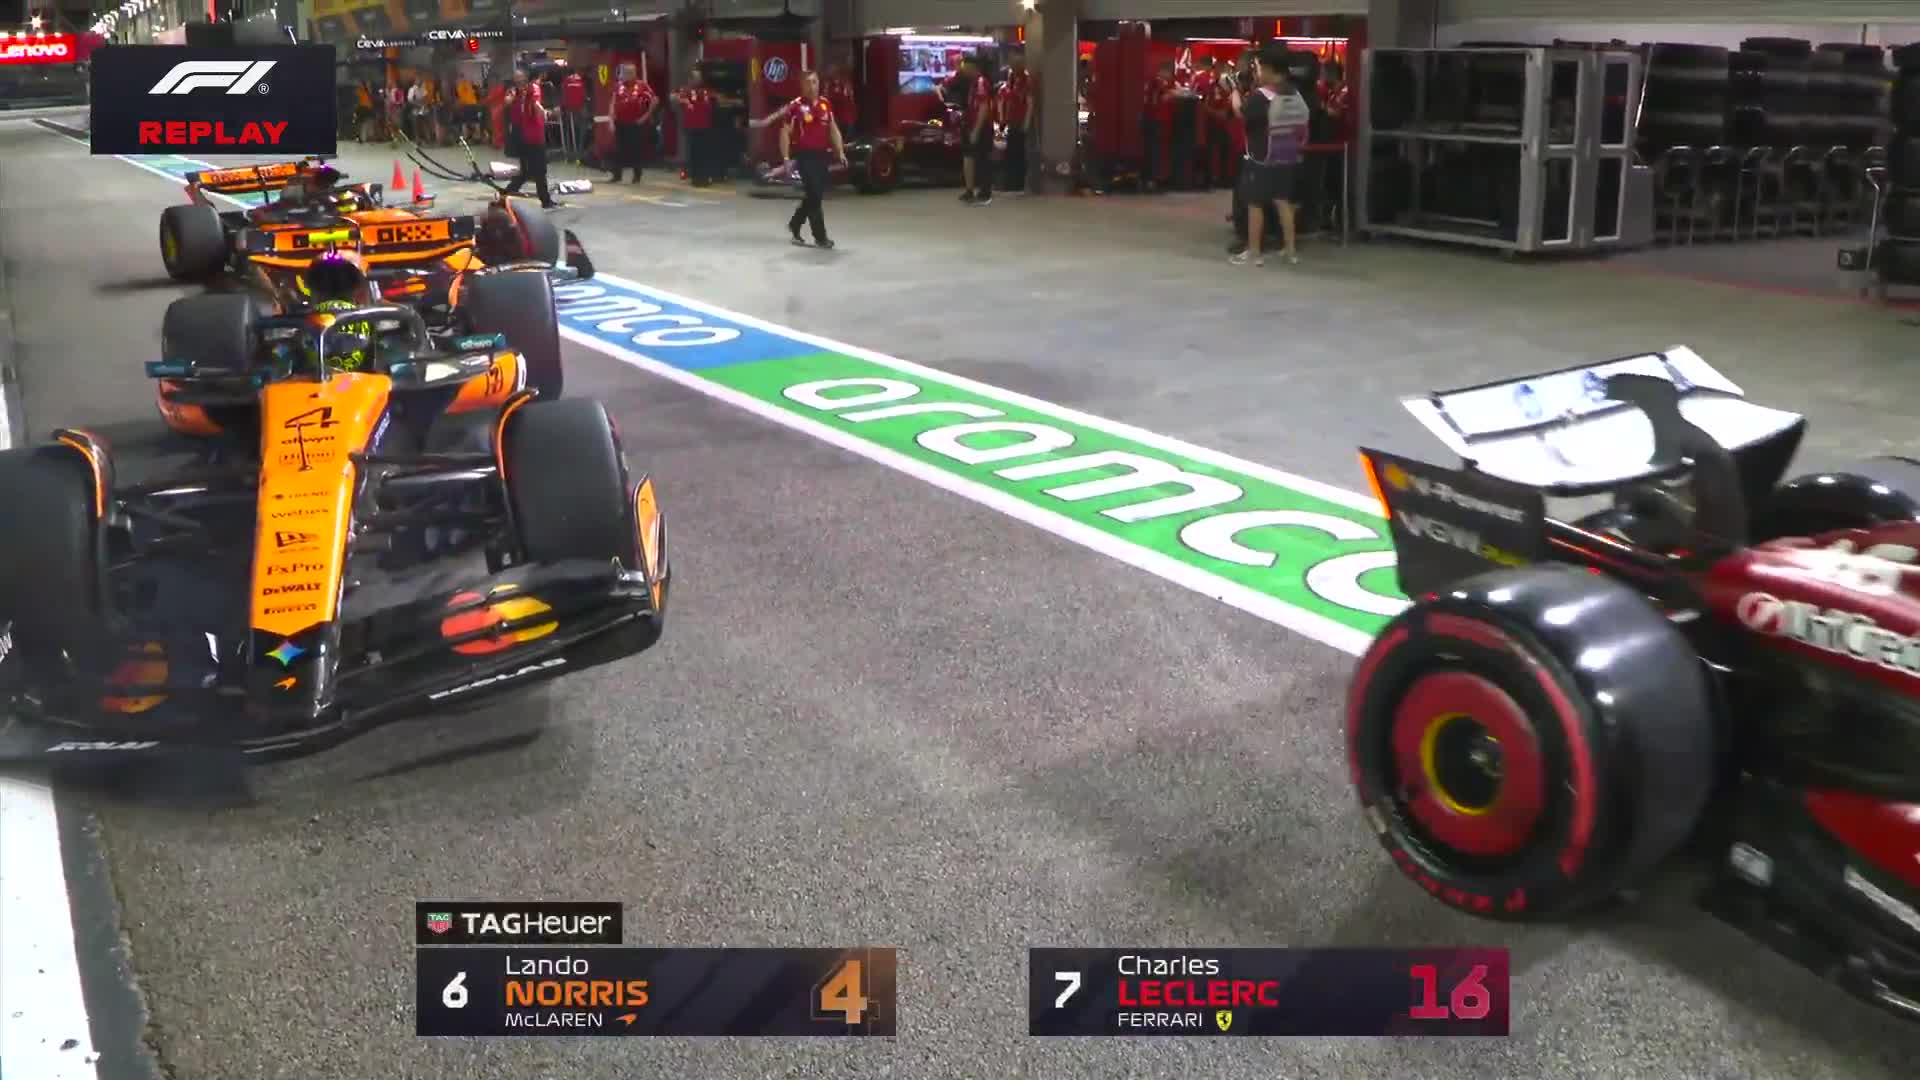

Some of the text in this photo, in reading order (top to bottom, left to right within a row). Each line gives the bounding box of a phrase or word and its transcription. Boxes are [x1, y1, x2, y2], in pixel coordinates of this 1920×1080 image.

[428, 29, 466, 40] CEVA
[357, 38, 387, 48] CEVA
[284, 406, 340, 429] 4
